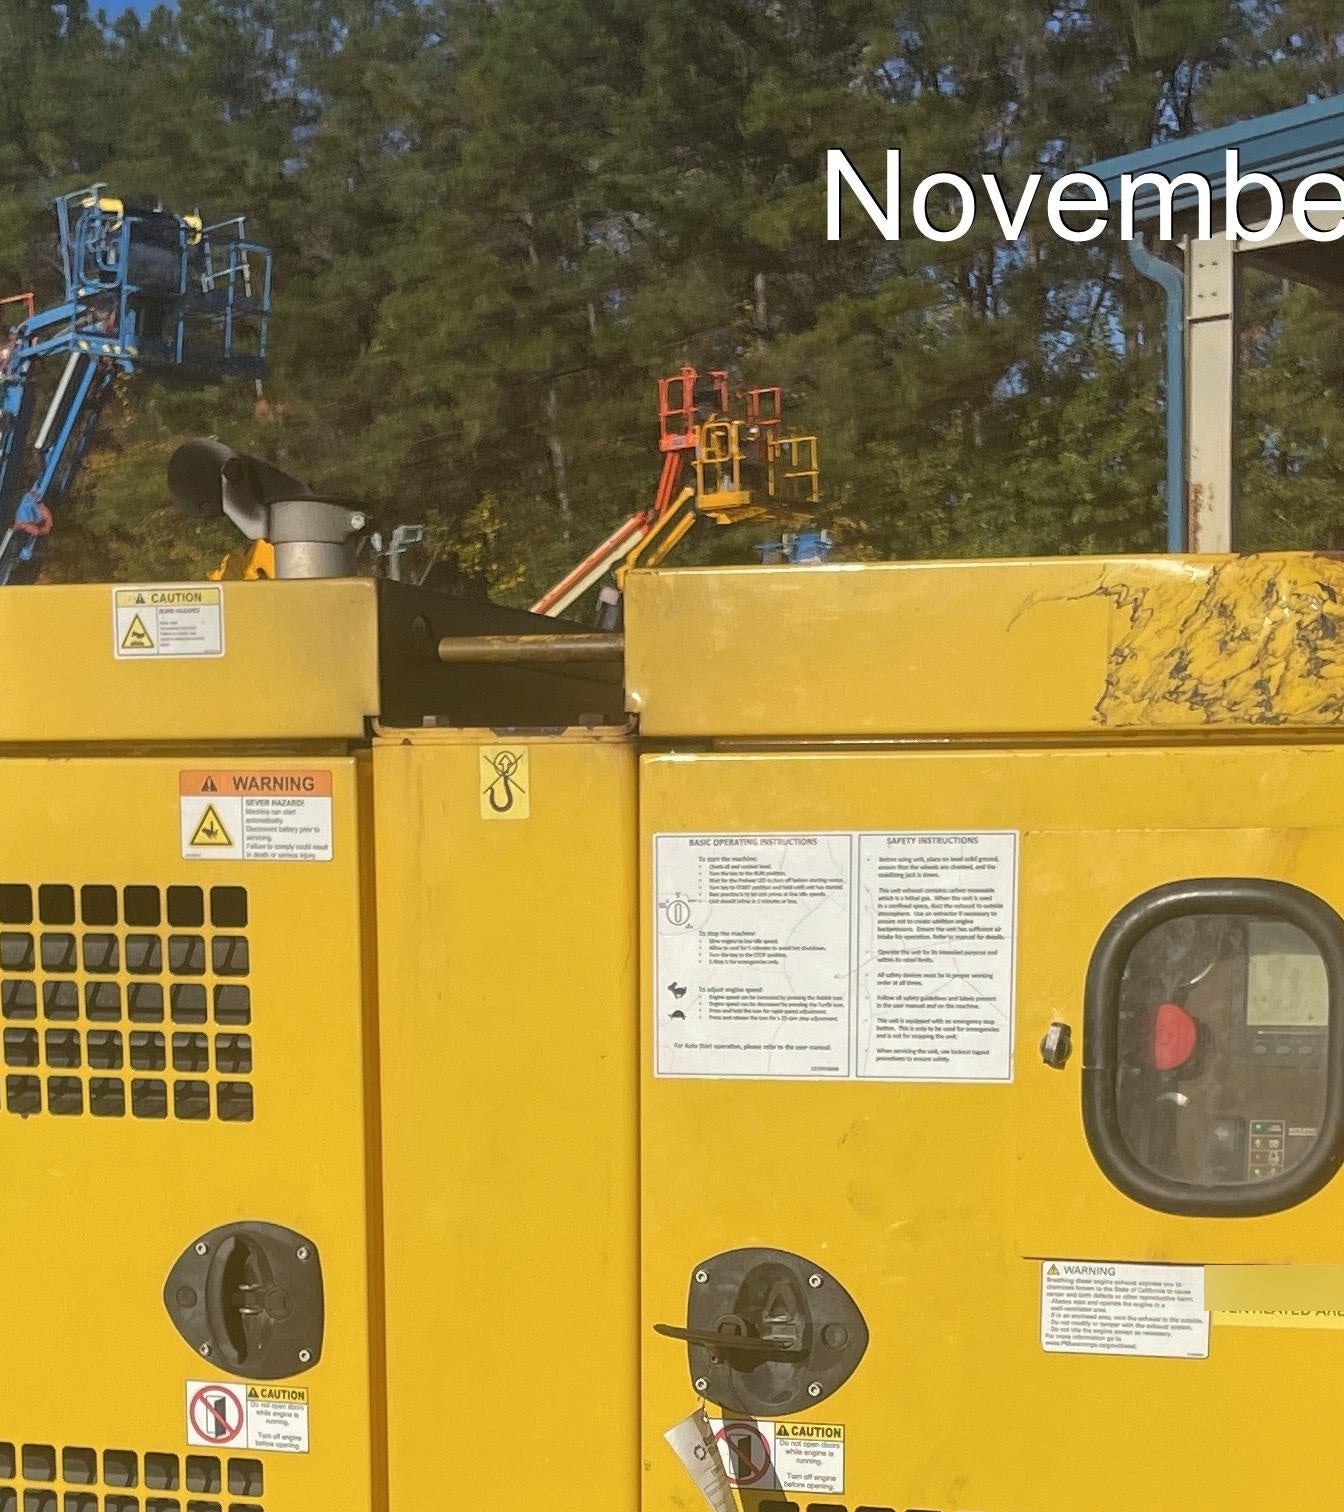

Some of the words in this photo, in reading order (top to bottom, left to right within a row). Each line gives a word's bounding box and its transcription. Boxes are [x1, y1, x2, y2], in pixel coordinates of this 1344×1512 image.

[151, 592, 202, 604] CAUTION
[233, 776, 315, 791] WARNING
[760, 838, 818, 846] INSTRUCTIONS
[887, 837, 915, 845] SAFETY
[1063, 1265, 1116, 1277] WARNING
[261, 1389, 305, 1400] CAUTION
[791, 1426, 841, 1438] CAUTION
